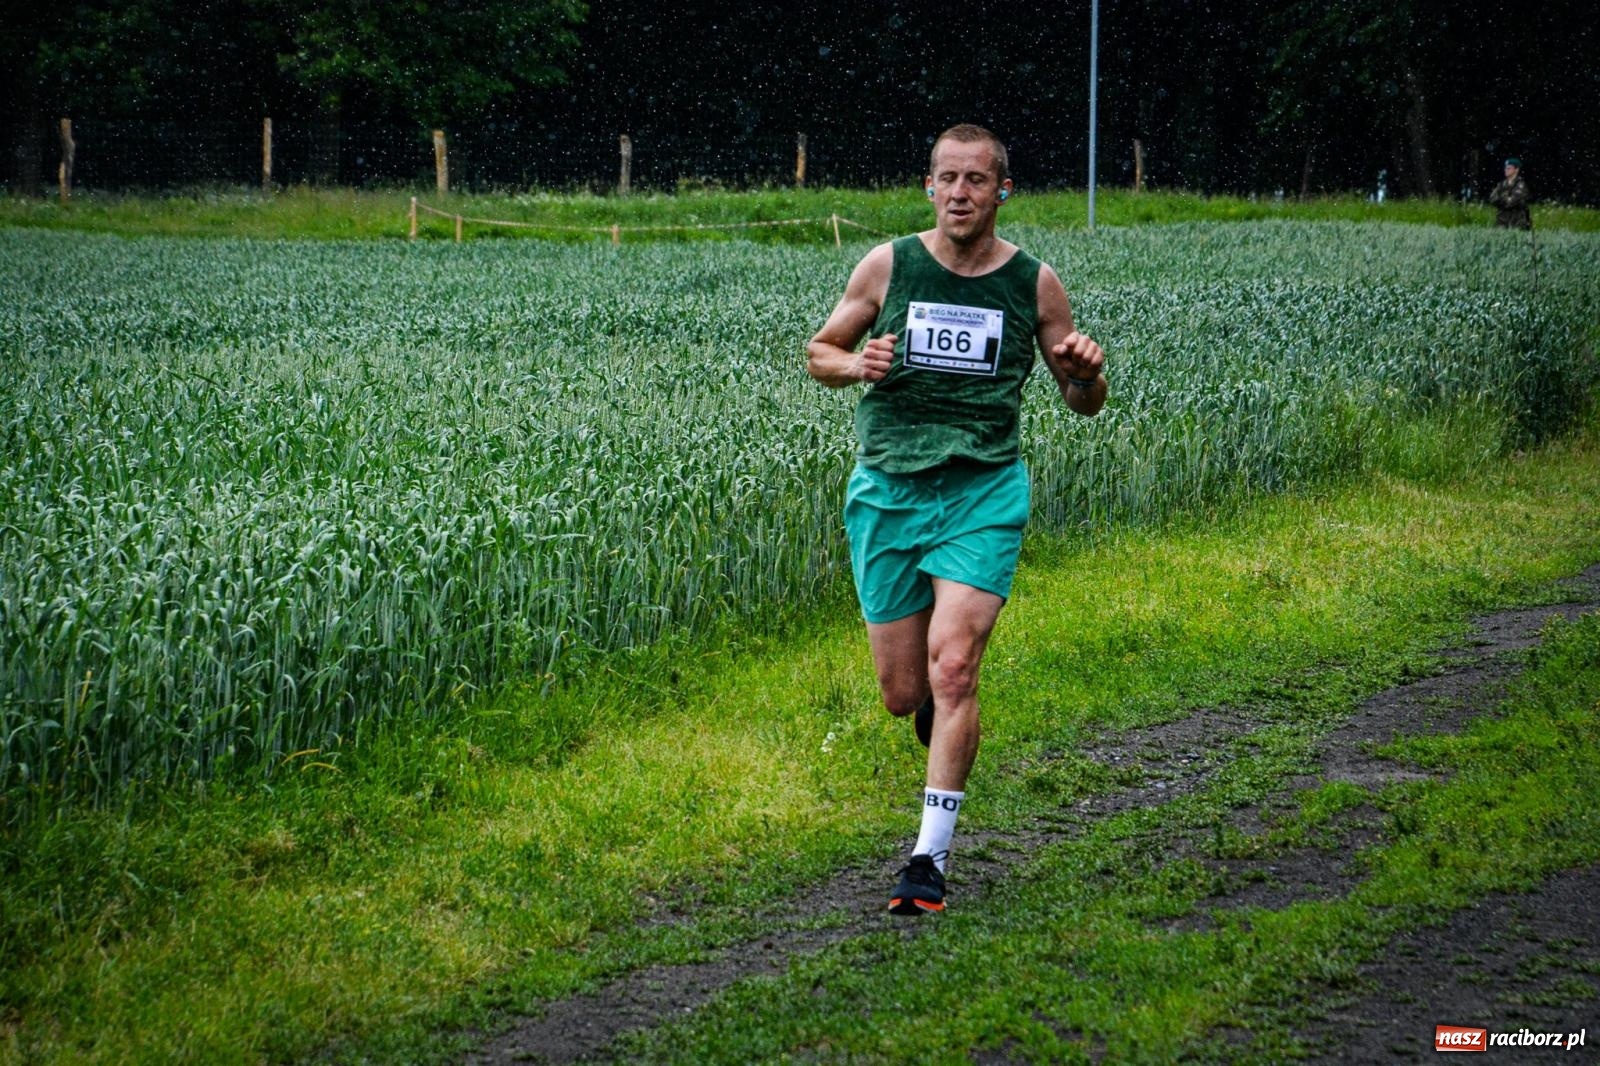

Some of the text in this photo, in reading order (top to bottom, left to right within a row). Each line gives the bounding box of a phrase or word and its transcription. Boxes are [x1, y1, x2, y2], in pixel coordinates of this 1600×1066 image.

[929, 308, 946, 316] BIEG
[926, 327, 972, 353] 166
[926, 794, 961, 812] BO
